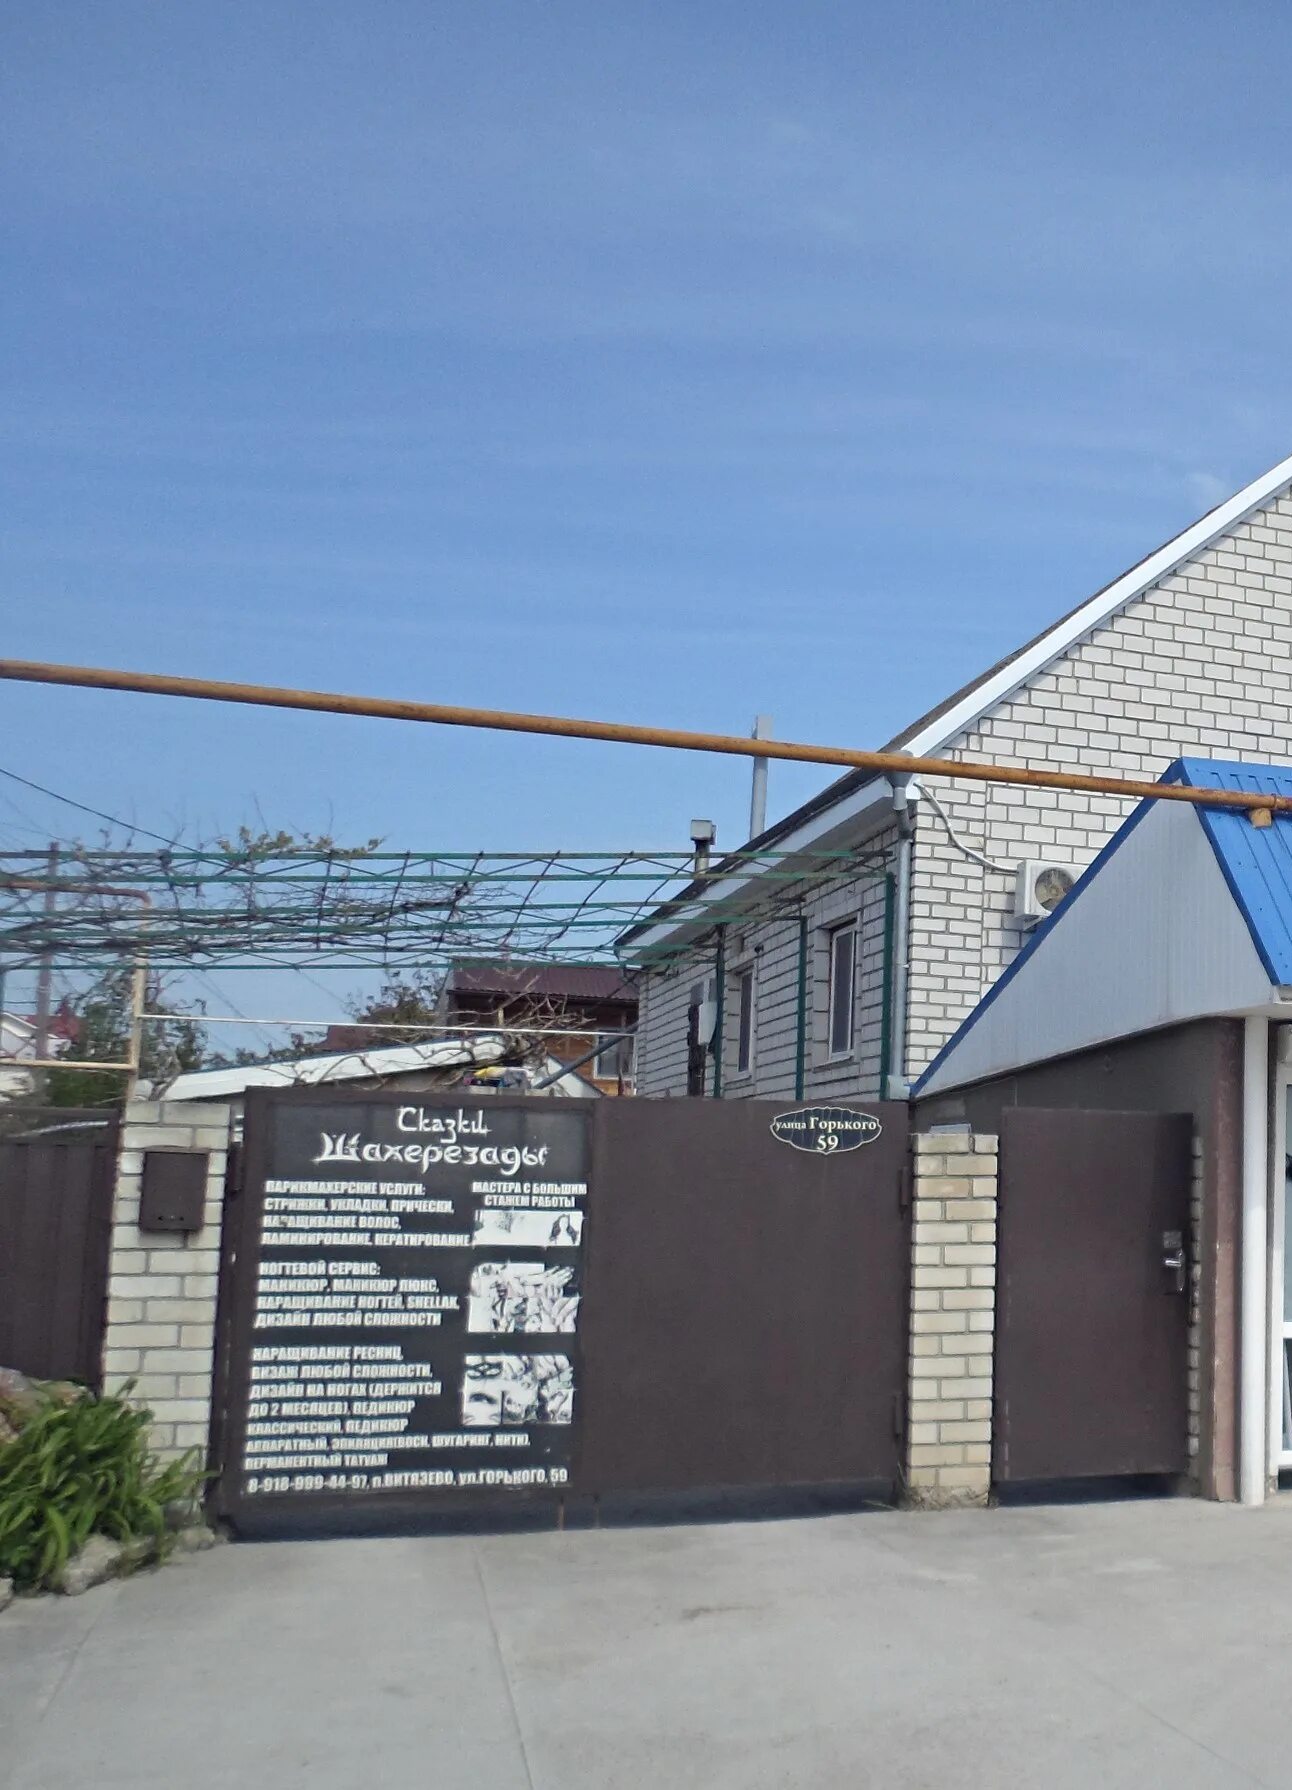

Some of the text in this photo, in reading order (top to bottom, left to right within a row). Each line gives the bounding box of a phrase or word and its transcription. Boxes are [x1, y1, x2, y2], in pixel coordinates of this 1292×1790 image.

[397, 1106, 491, 1143] Сказки
[775, 1117, 877, 1133] улица Горького
[816, 1135, 838, 1150] 59
[311, 1131, 550, 1175] Шахерезады
[265, 1180, 426, 1195] ПАРИКМАХЕРСКИЕ УСЛУГИ:
[472, 1181, 587, 1194] МАСТЕРА С БОЛЬШИМ
[264, 1198, 455, 1214] СТРИЖКИ, УКЛАДКИ, ПРИЧЕСКИ,
[484, 1194, 575, 1207] СТАЖЕМ РАБОТЫ
[358, 1216, 401, 1230] ВОЛОС,
[259, 1260, 381, 1275] НОГТЕВОЙ СЕРВИС:
[333, 1279, 397, 1292] МАНИКЮР
[399, 1280, 439, 1292] ЛЮКС,
[257, 1296, 356, 1310] НАРАЩИВАНИЕ
[357, 1294, 404, 1309] НОГТЕЙ,
[254, 1310, 441, 1328] ДИЗАЙН ЛЮБОЙ СЛОЖНОСТИ
[253, 1346, 352, 1361] НАРАЩИВАНИЕ
[252, 1362, 432, 1379] ВИЗАЖ ЛЮБОЙ СЛОЖНОСТИ,
[250, 1382, 304, 1399] ДИЗАЙН
[306, 1383, 325, 1397] НА
[326, 1383, 367, 1397] НОГАХ
[249, 1403, 268, 1418] ДО
[270, 1403, 280, 1416] 2
[353, 1400, 416, 1415] ПЕДИКЮР
[345, 1418, 408, 1433] ПЕДИКЮР
[245, 1453, 388, 1470] ПЕРМАНЕНТНЫЙ ТАТУАЖ
[550, 1468, 567, 1483] 59
